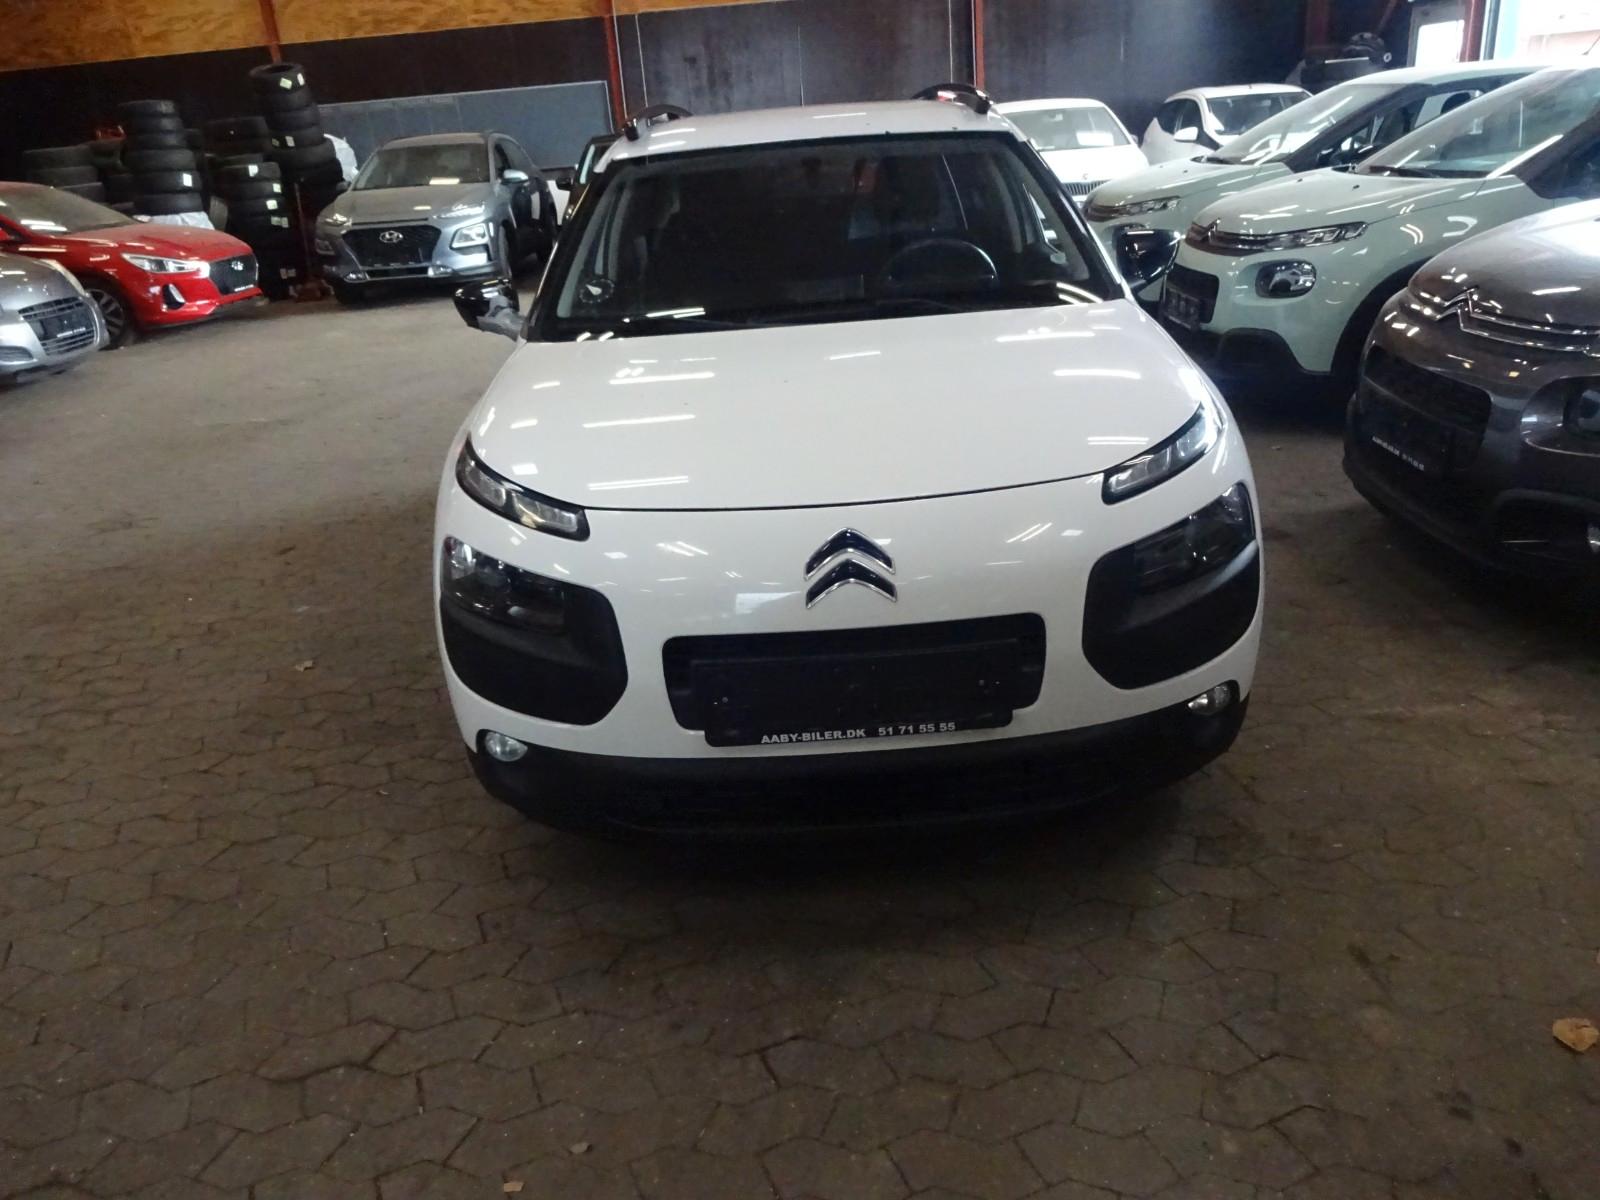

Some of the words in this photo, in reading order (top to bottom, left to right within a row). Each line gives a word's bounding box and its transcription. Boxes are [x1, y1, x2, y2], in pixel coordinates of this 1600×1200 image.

[761, 728, 866, 744] AABY-BILER.DK
[878, 726, 893, 736] 51
[899, 725, 914, 735] 71
[919, 723, 935, 733] 55
[939, 721, 956, 732] 55
